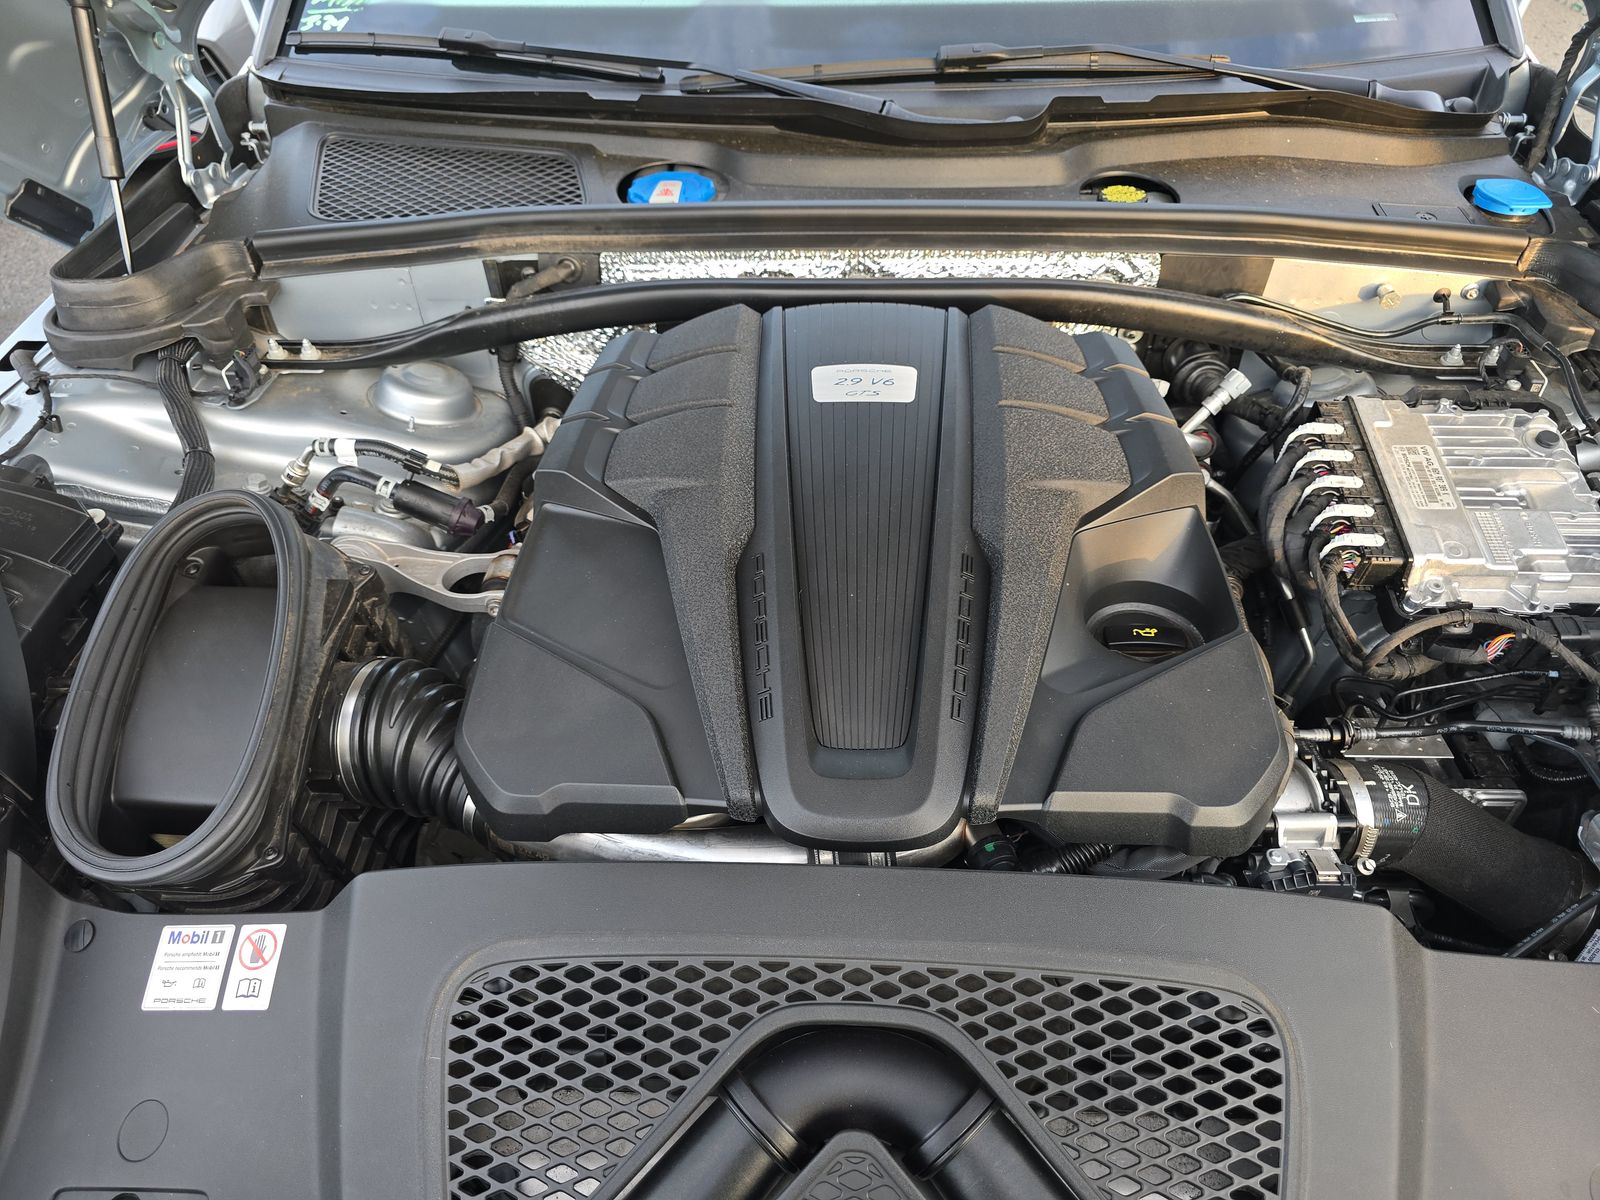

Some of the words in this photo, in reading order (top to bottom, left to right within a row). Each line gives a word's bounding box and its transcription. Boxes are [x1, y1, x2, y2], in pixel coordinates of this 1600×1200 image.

[833, 377, 863, 386] 2.9
[871, 377, 895, 386] V6
[752, 553, 774, 723] PORSCHE
[950, 553, 975, 724] PORSCHE
[1400, 784, 1420, 805] DK
[168, 930, 210, 944] Mobil
